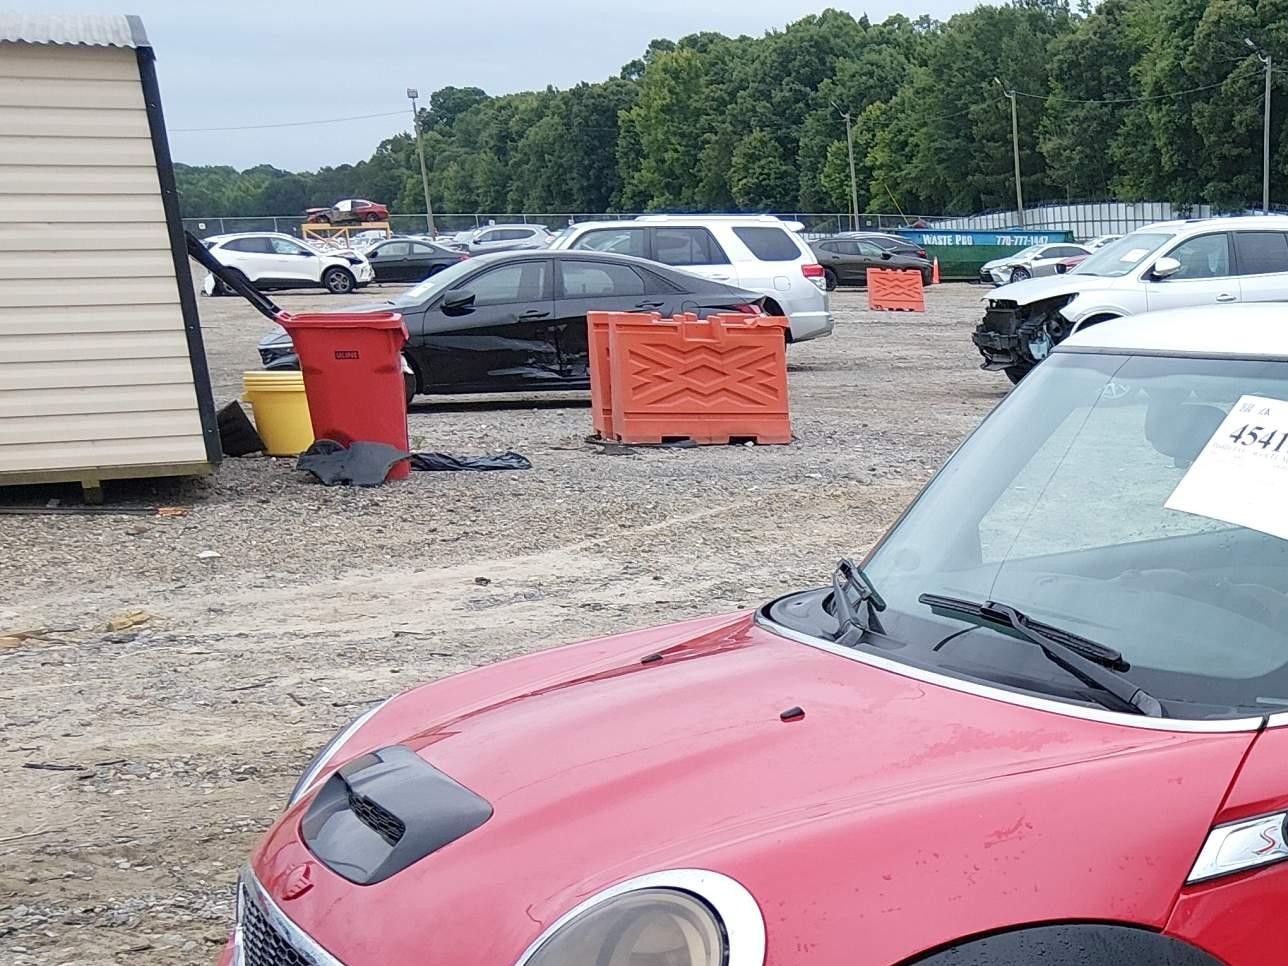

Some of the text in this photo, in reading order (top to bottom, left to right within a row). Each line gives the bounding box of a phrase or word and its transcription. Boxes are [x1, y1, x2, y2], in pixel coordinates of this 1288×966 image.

[922, 234, 973, 246] WASTE PRO
[1257, 826, 1278, 855] S
